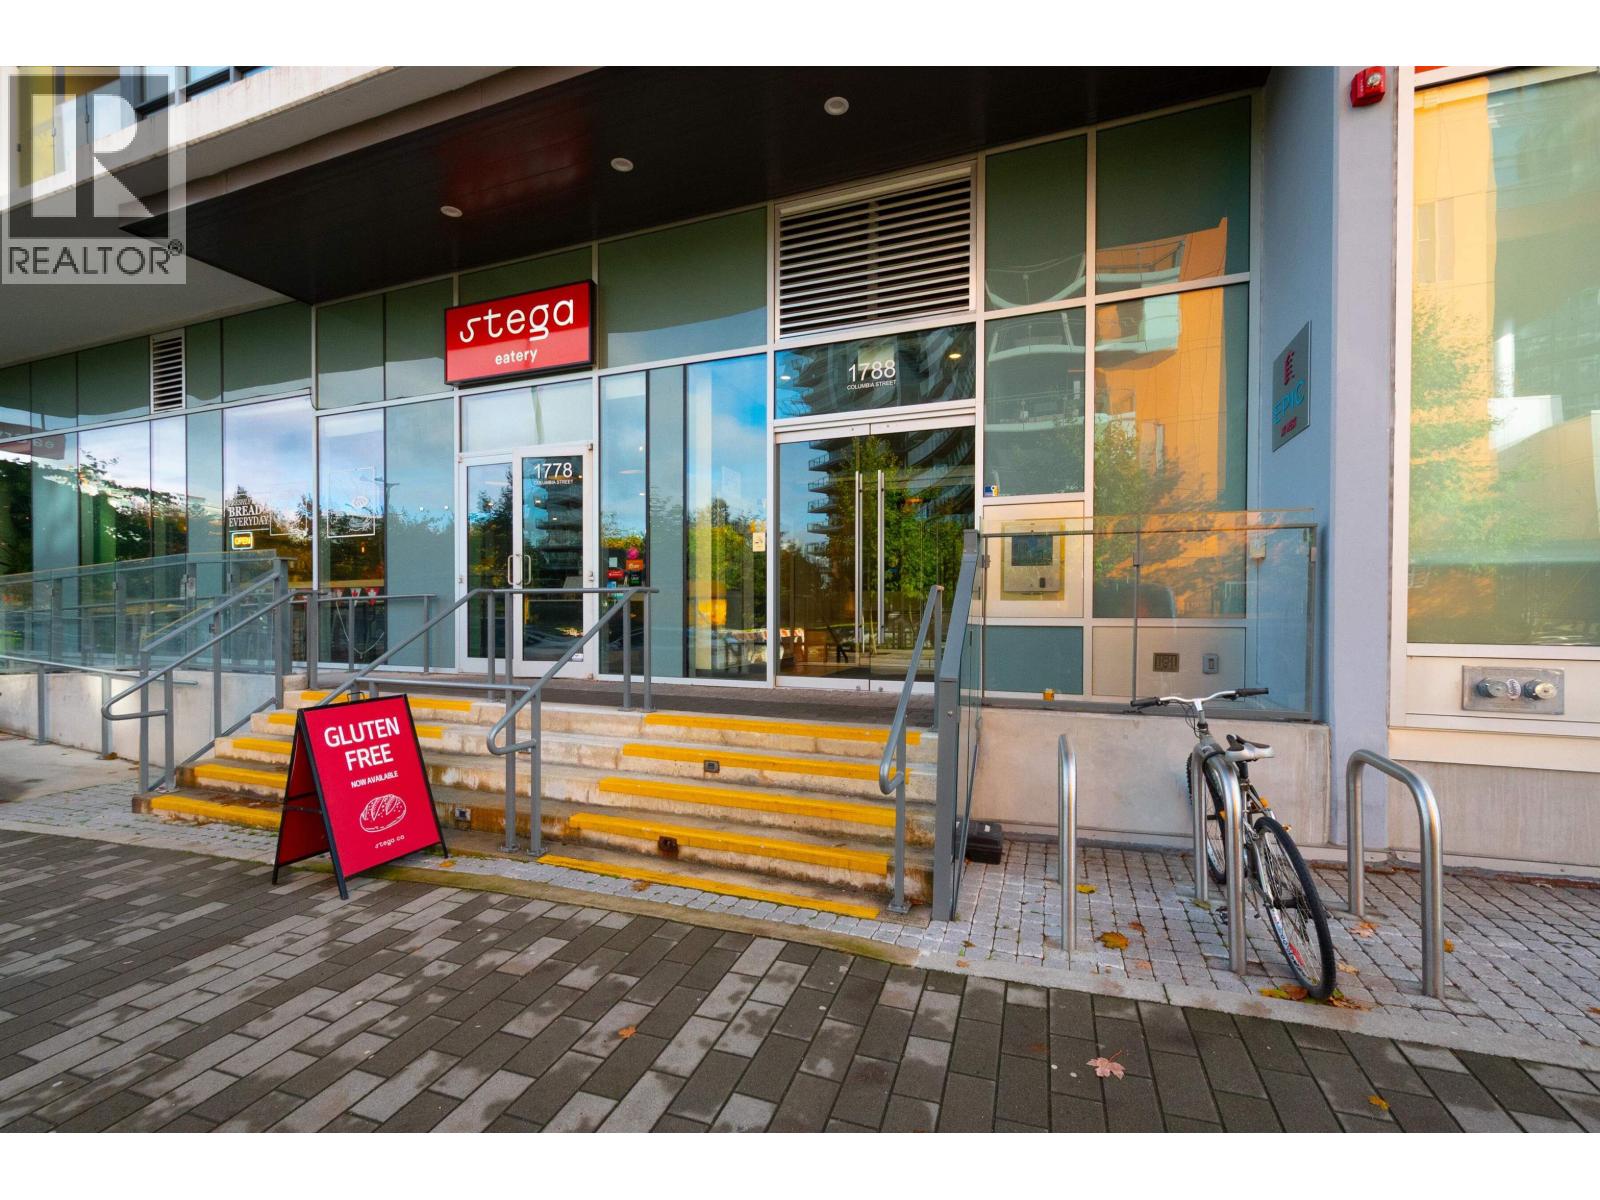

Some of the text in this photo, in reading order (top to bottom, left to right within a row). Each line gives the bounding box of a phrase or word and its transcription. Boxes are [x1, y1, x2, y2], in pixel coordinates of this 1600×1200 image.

[459, 299, 574, 343] stega
[495, 349, 538, 365] eatery
[848, 359, 896, 382] 1788
[534, 462, 573, 479] 1778
[228, 504, 262, 517] BREAD
[228, 515, 269, 528] EVERYDAY
[233, 536, 251, 545] OPEN
[324, 716, 400, 748] GLUTEN
[345, 743, 394, 772] FREE
[351, 770, 399, 788] NOW AVAILABLE
